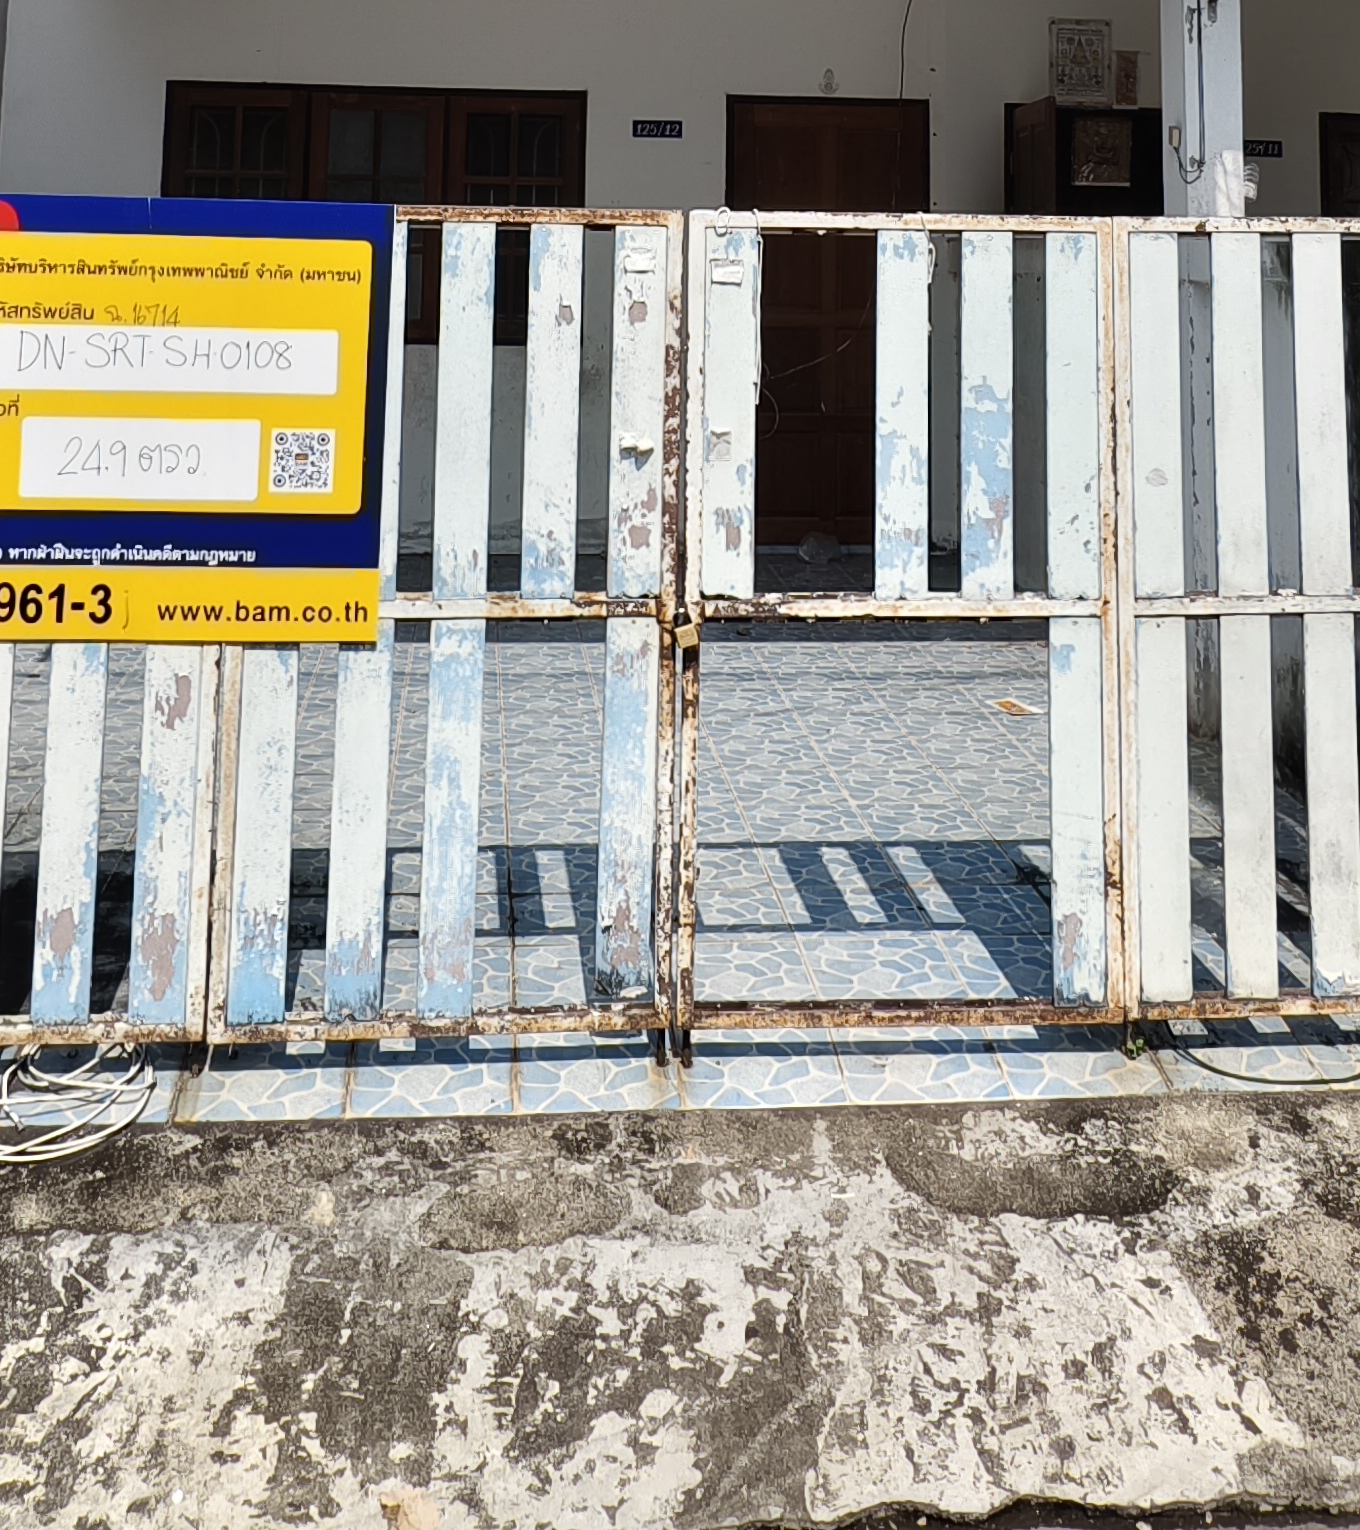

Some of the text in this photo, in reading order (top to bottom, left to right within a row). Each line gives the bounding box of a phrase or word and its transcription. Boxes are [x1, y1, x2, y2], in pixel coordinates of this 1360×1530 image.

[635, 121, 680, 136] 125/12
[255, 262, 294, 281] จำกัด
[299, 267, 362, 285] (มหาชน)
[56, 436, 127, 478] 24.9
[157, 600, 369, 623] www.bam.co.th
